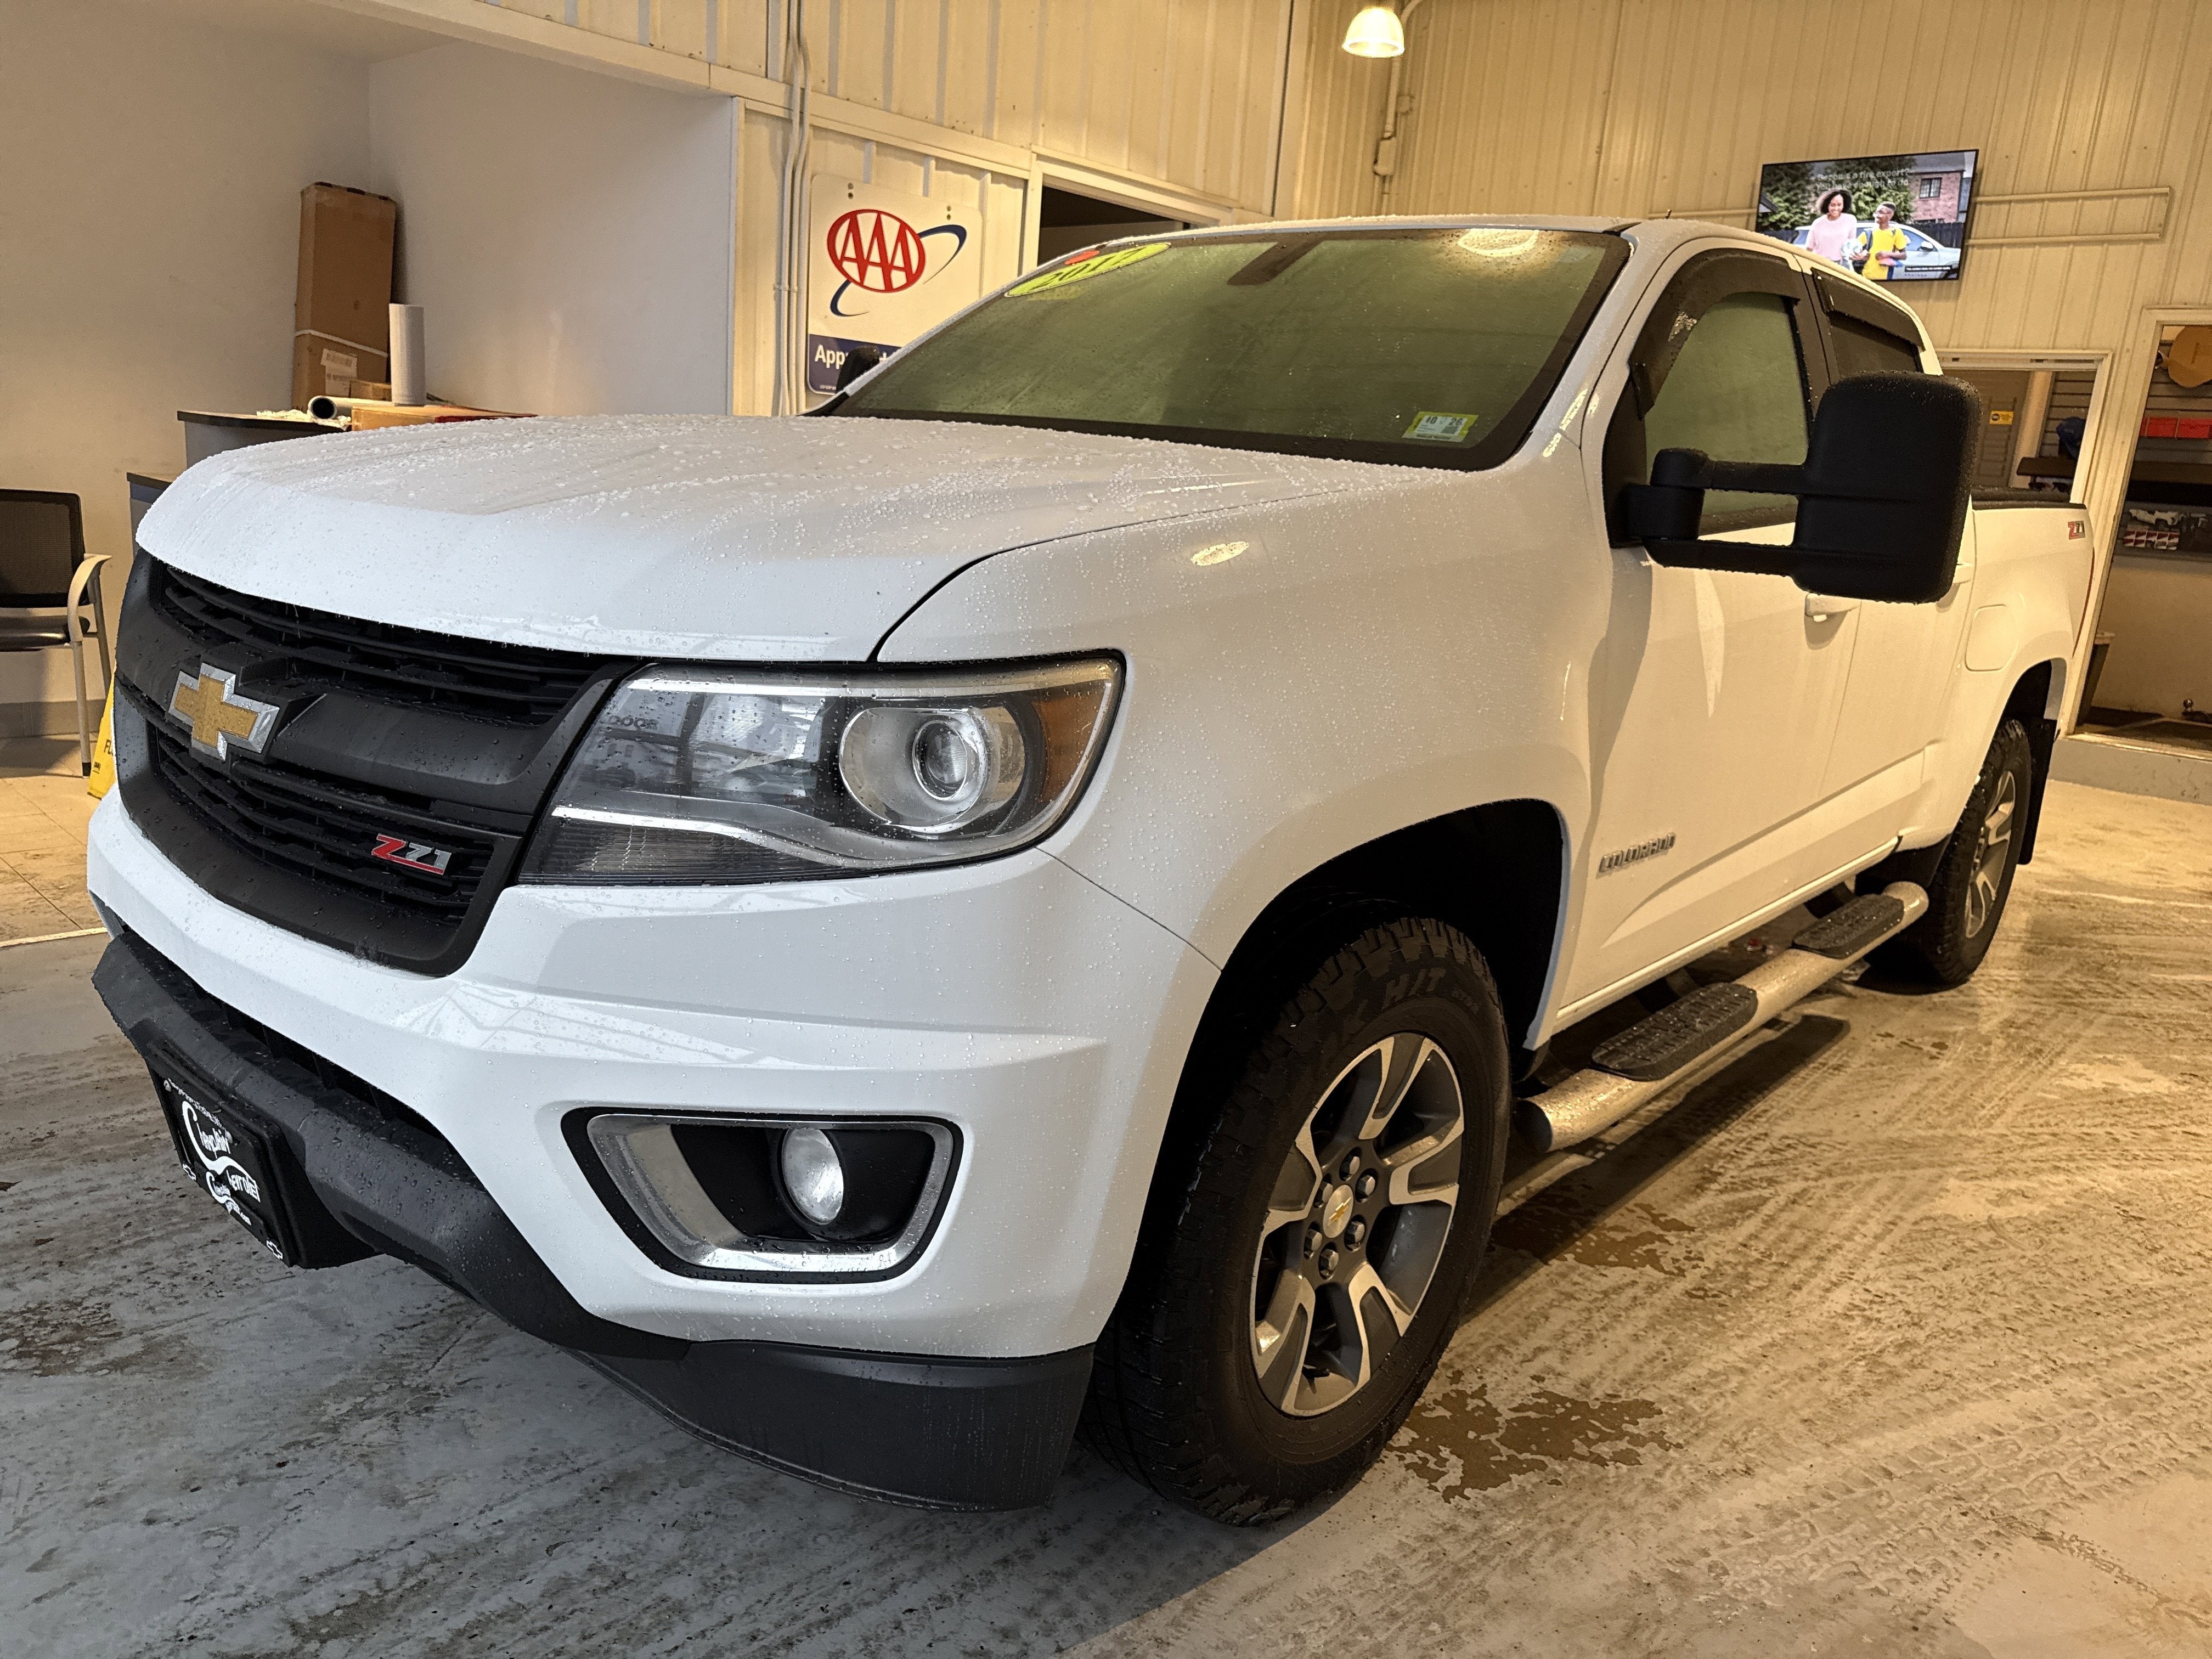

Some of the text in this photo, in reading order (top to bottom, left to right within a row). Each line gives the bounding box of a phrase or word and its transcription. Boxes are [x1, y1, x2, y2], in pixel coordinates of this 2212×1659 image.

[837, 210, 918, 292] AAA
[371, 833, 452, 876] Z71
[1599, 832, 1677, 873] COLORADO
